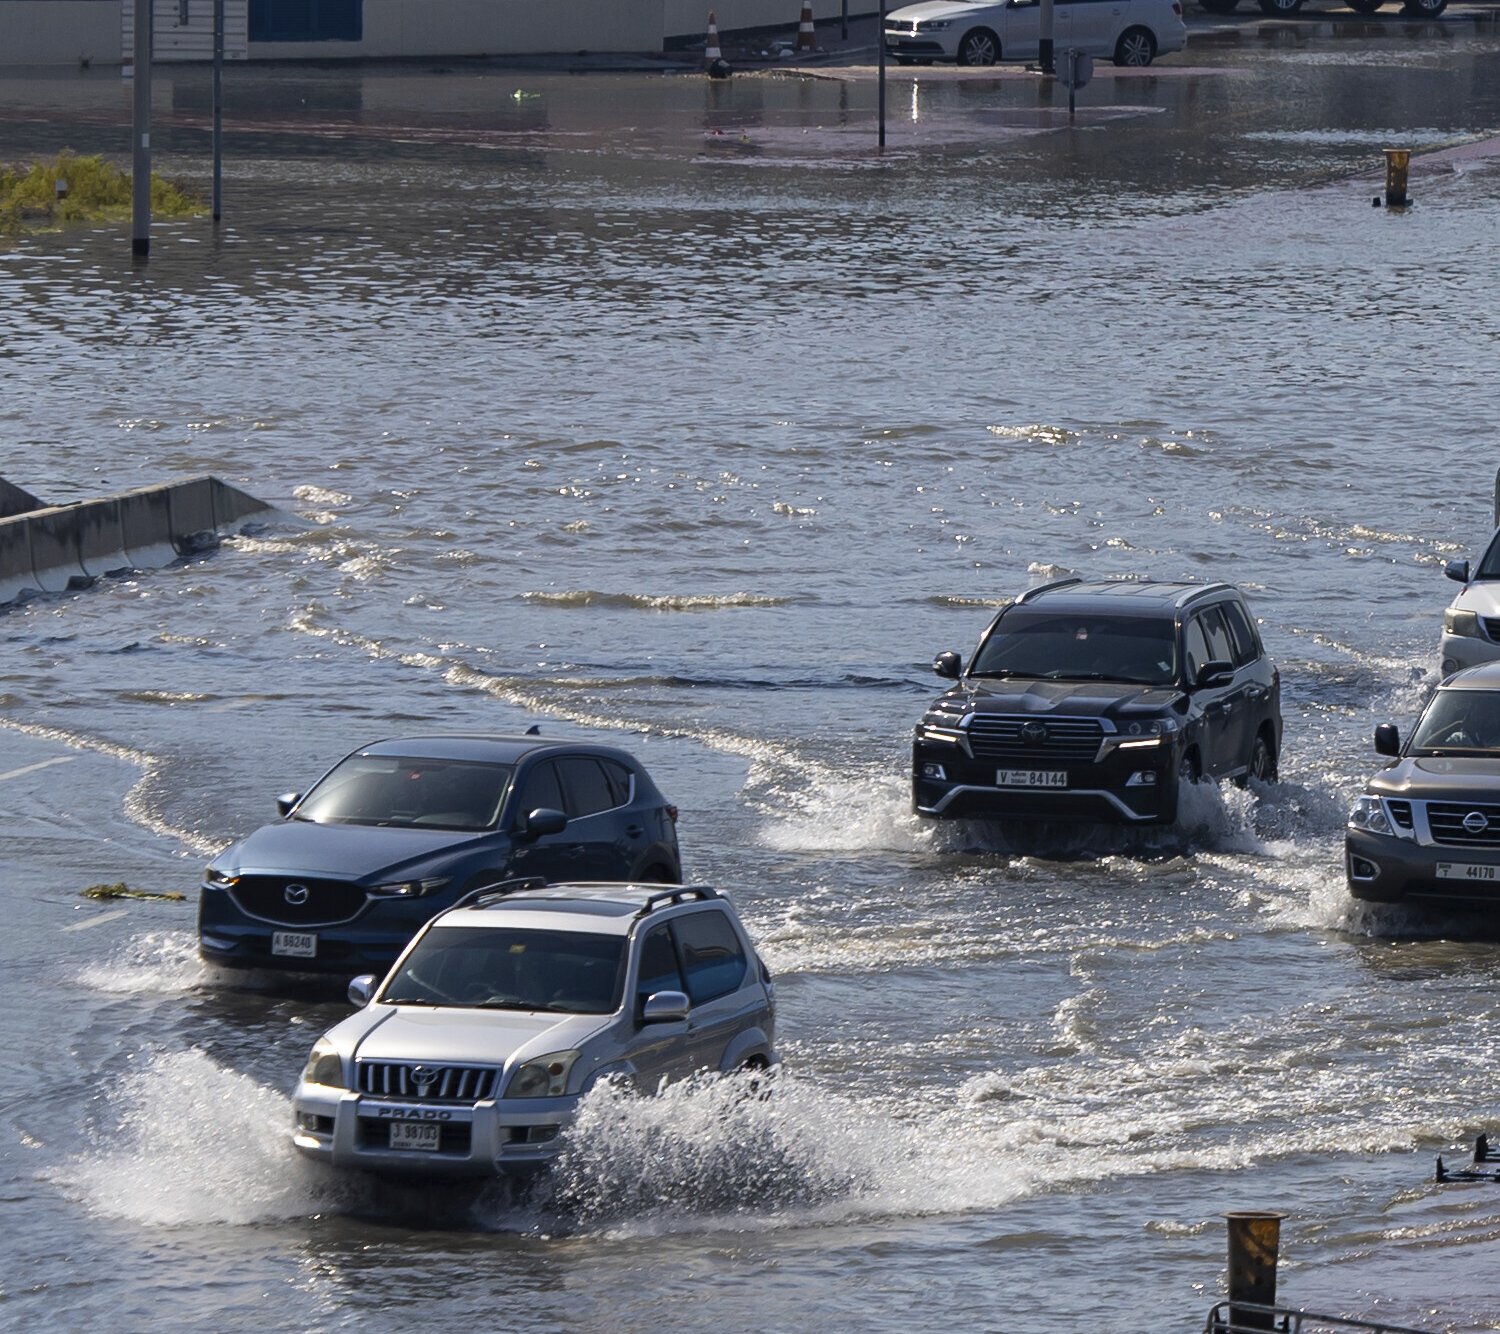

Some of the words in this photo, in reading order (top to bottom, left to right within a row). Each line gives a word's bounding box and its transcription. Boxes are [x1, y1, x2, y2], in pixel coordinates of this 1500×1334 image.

[1000, 772, 1008, 784] V
[1029, 773, 1065, 785] 84144
[1466, 866, 1495, 879] 44170
[378, 1108, 452, 1120] PRADO
